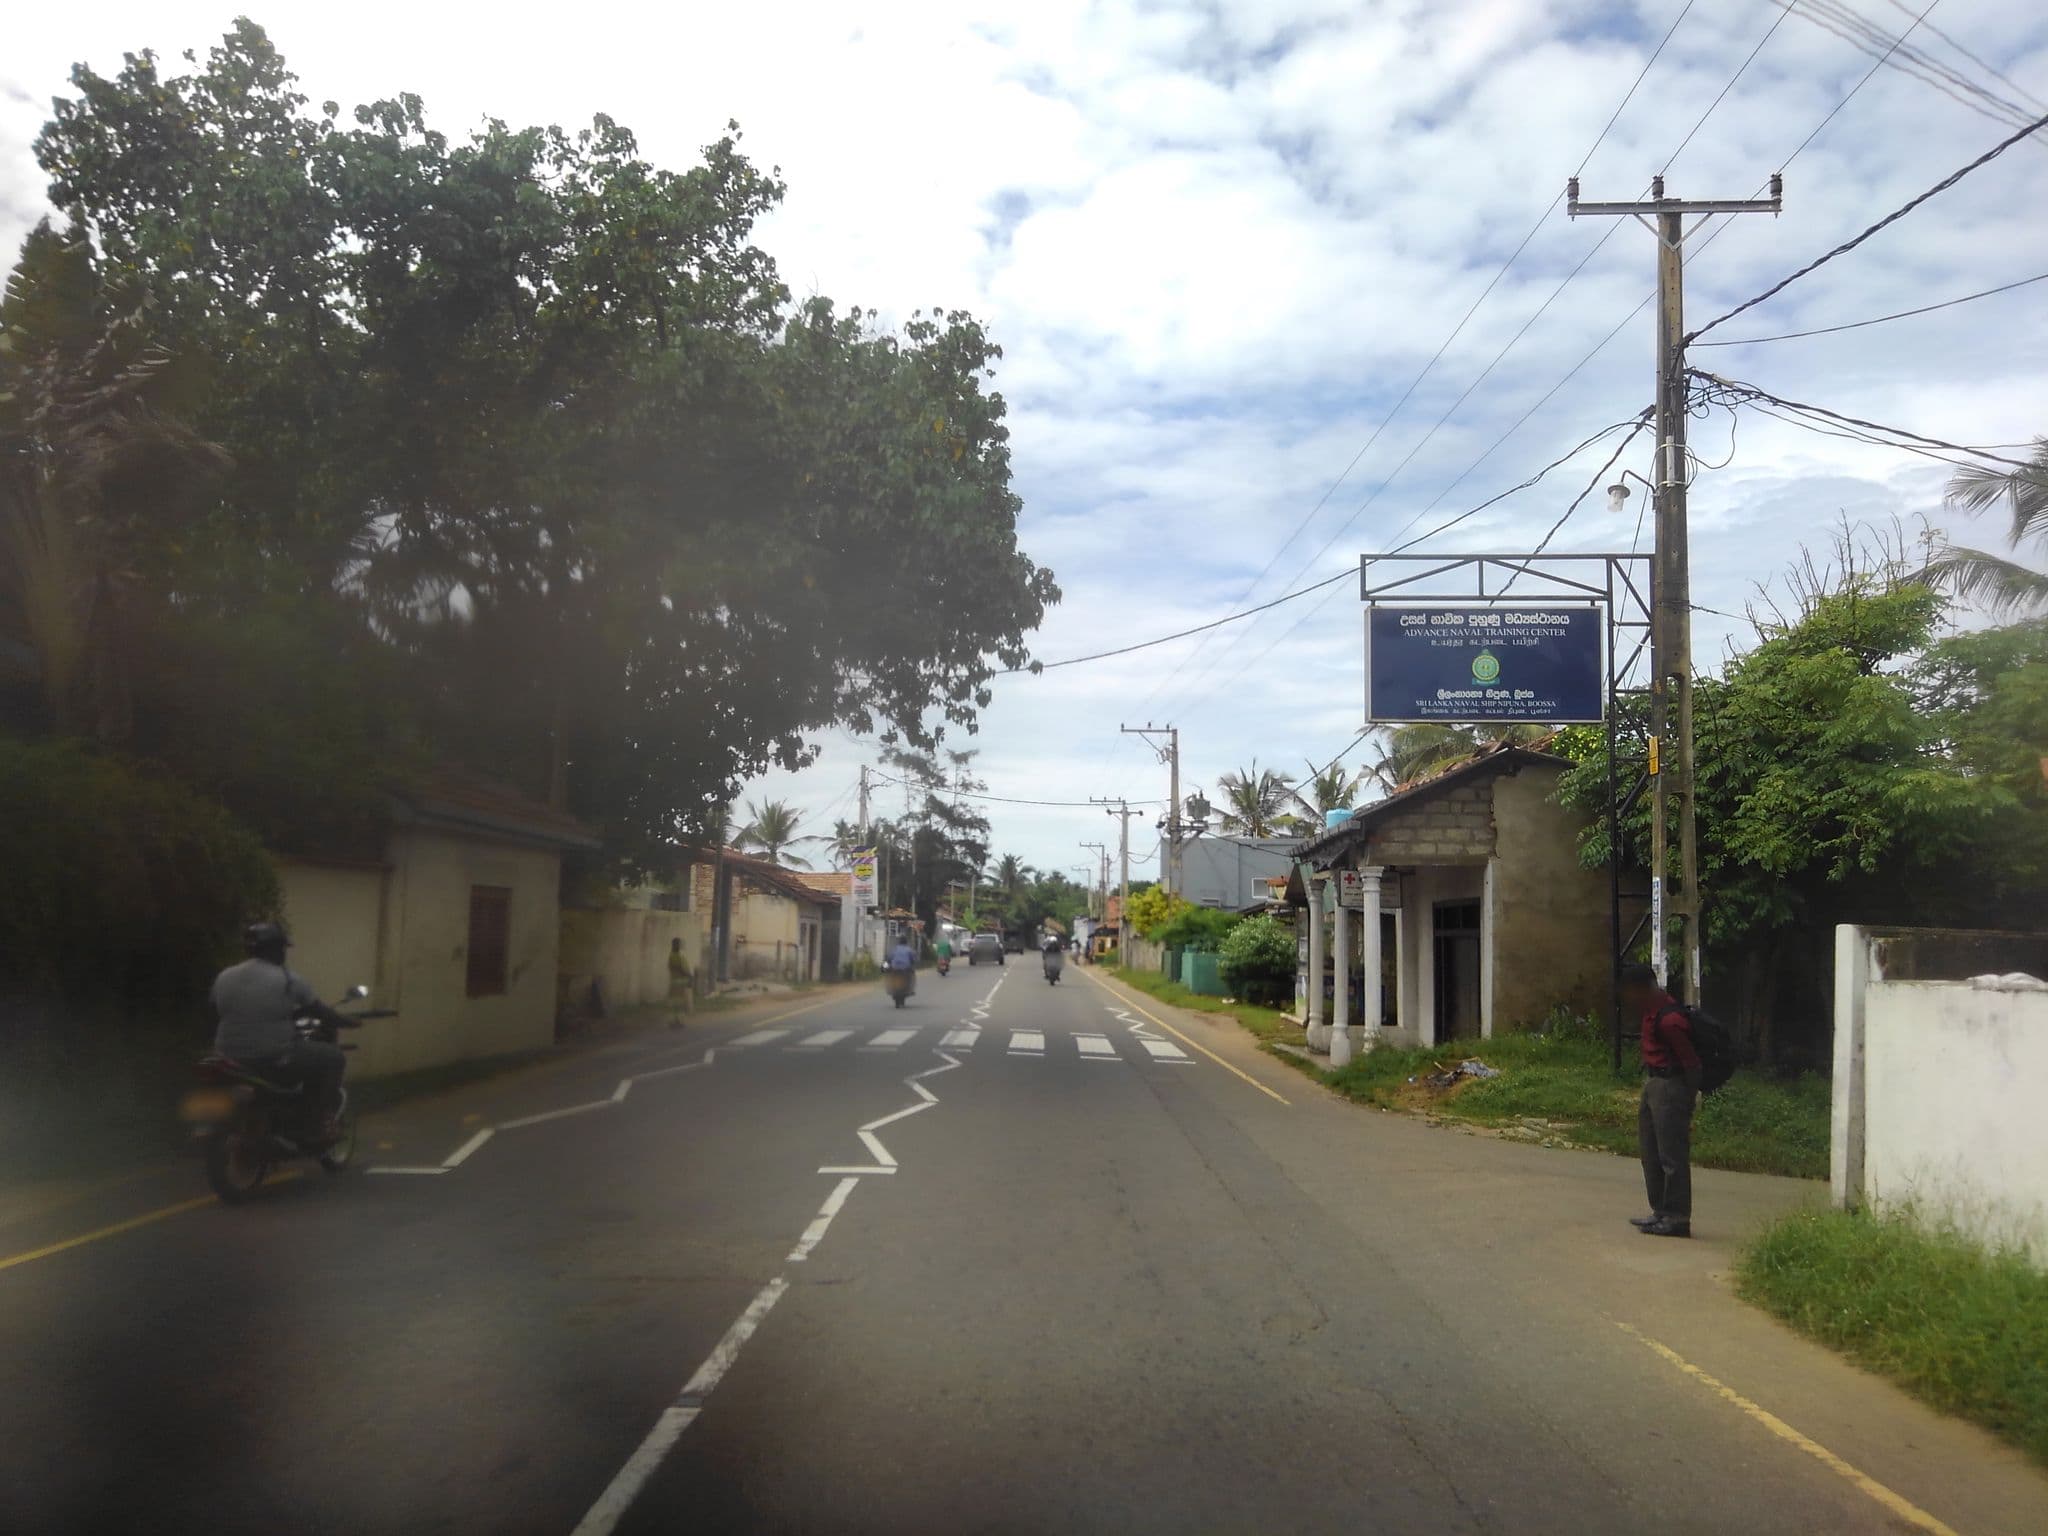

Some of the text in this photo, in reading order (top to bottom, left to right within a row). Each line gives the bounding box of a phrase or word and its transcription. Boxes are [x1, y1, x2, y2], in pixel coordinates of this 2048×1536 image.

[1404, 628, 1566, 637] ADVANCE NAVAL TRAINING CENTER
